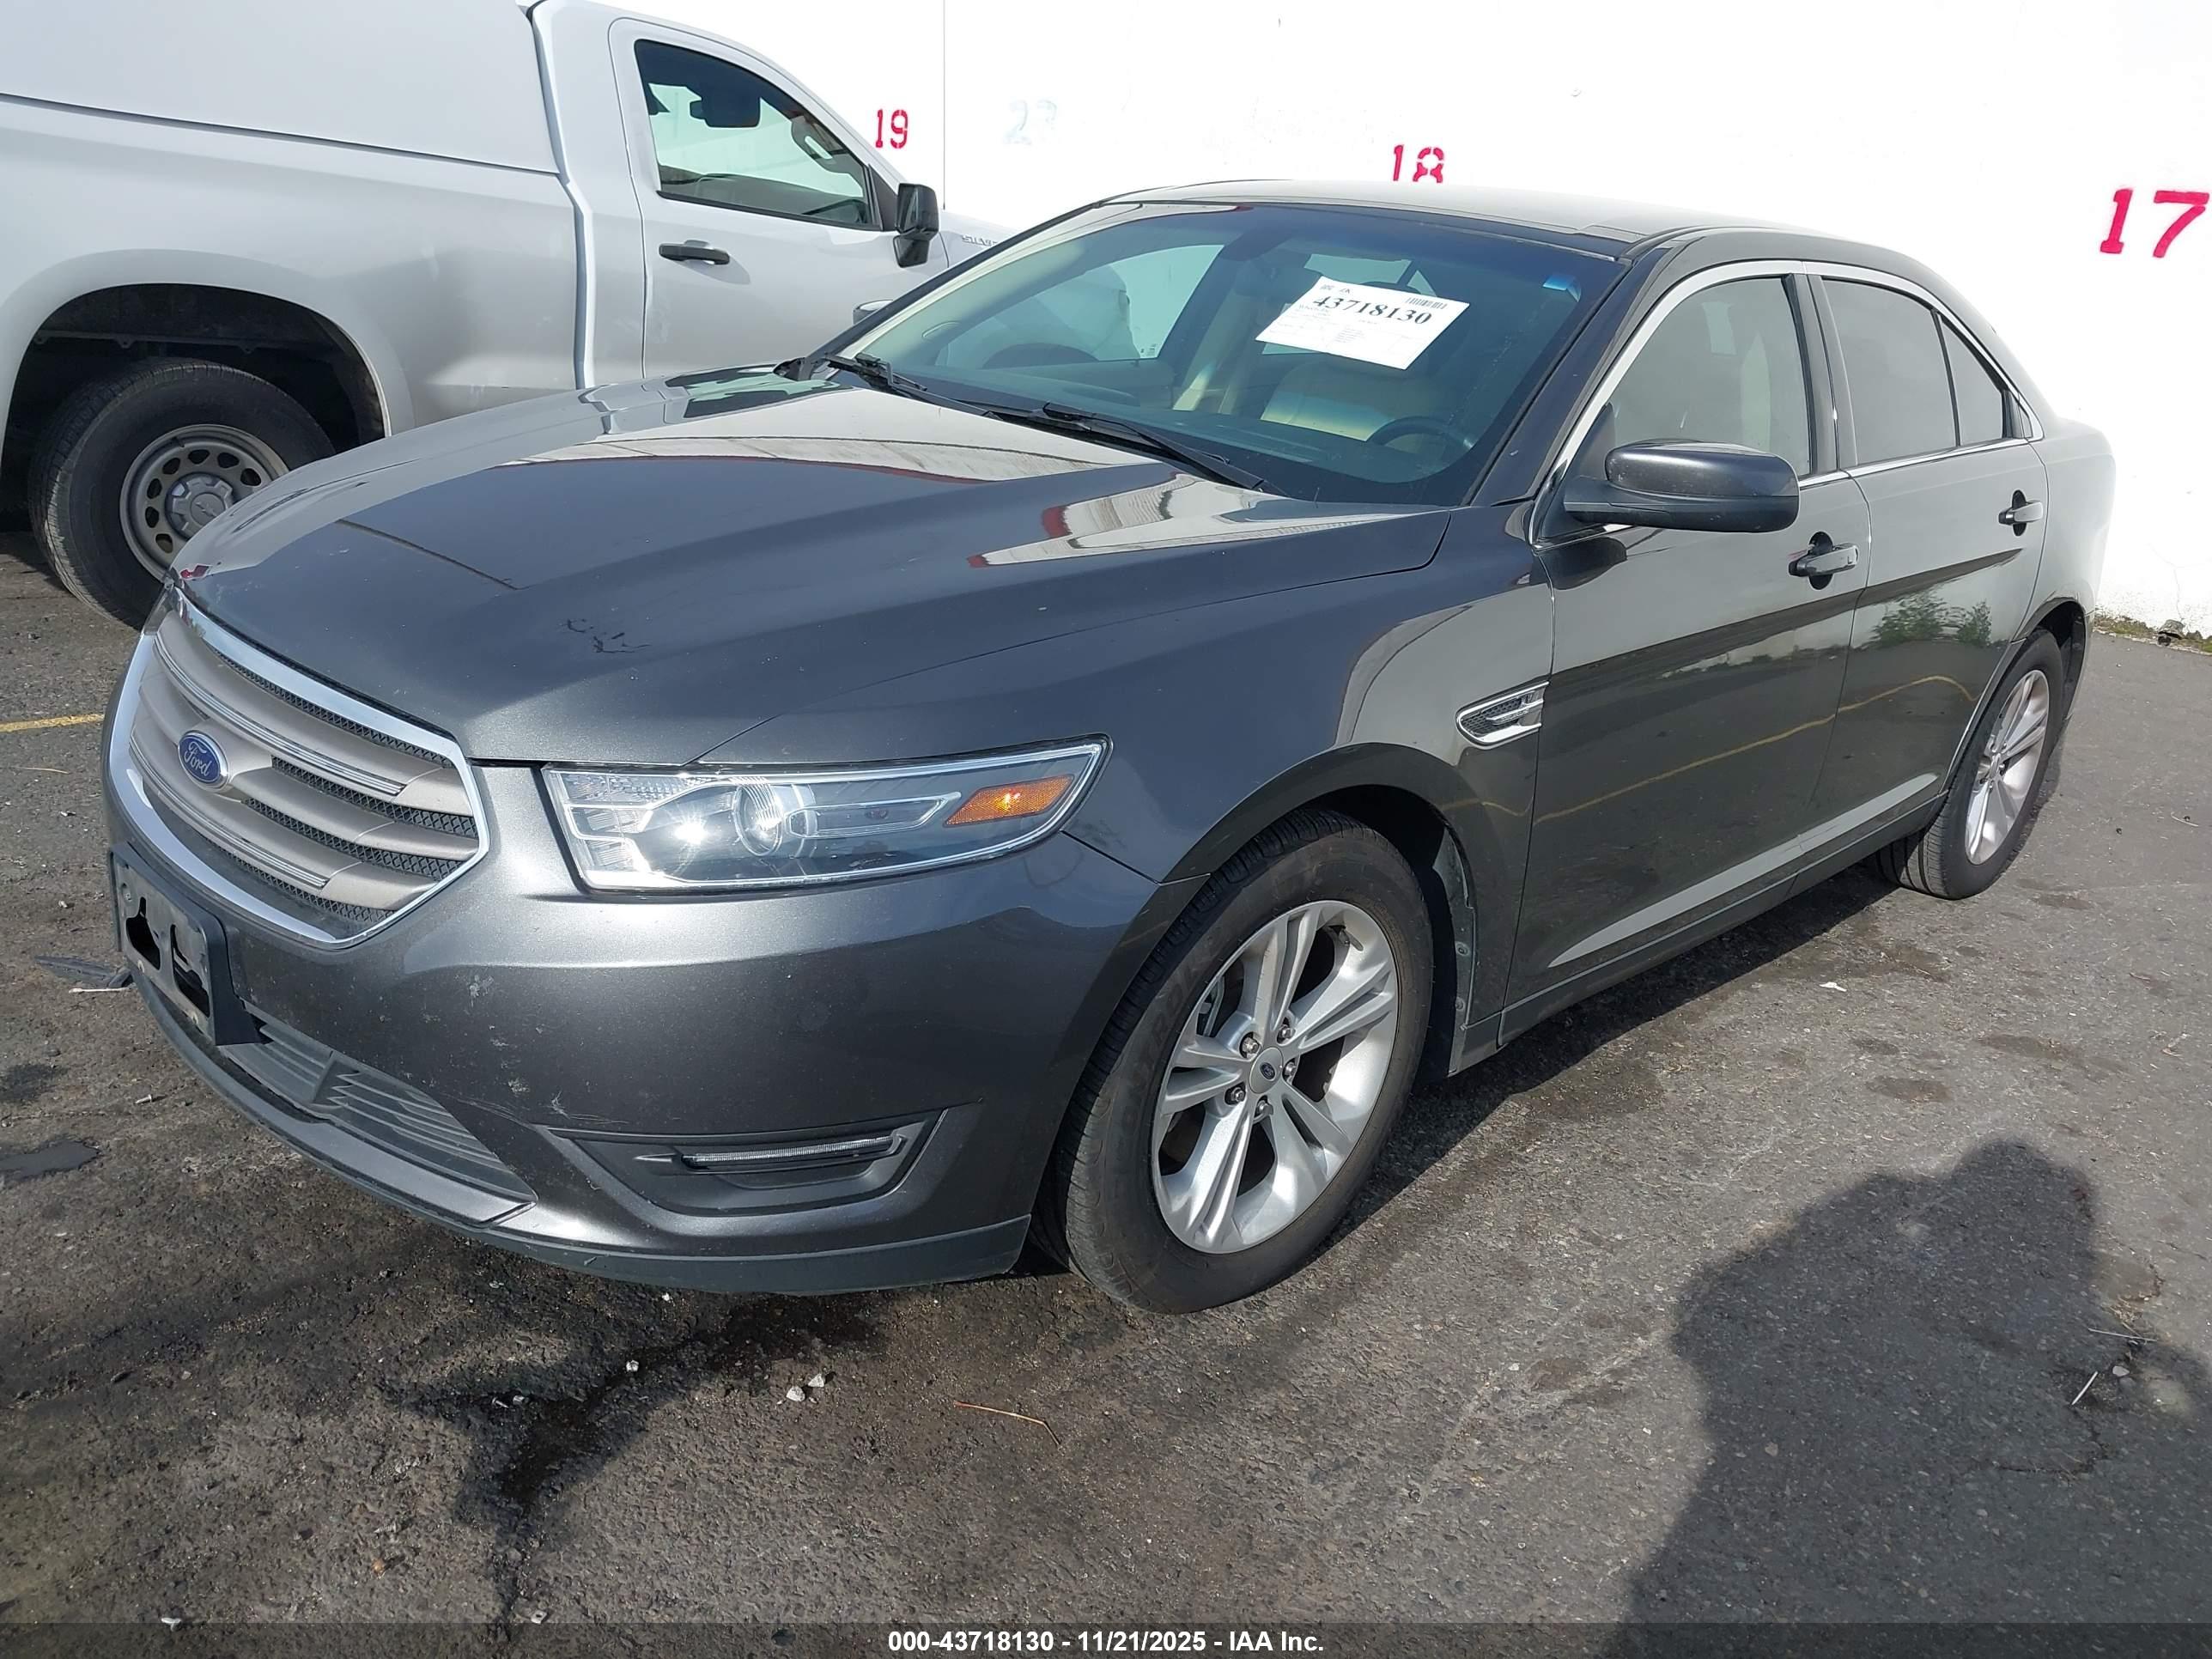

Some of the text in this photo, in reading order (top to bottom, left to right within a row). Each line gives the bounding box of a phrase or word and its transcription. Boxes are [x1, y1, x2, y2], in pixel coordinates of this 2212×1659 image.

[874, 109, 908, 149] 19
[1392, 144, 1444, 184] 18
[2099, 187, 2210, 258] 17
[1313, 296, 1432, 324] 43718130
[184, 741, 213, 777] Ford
